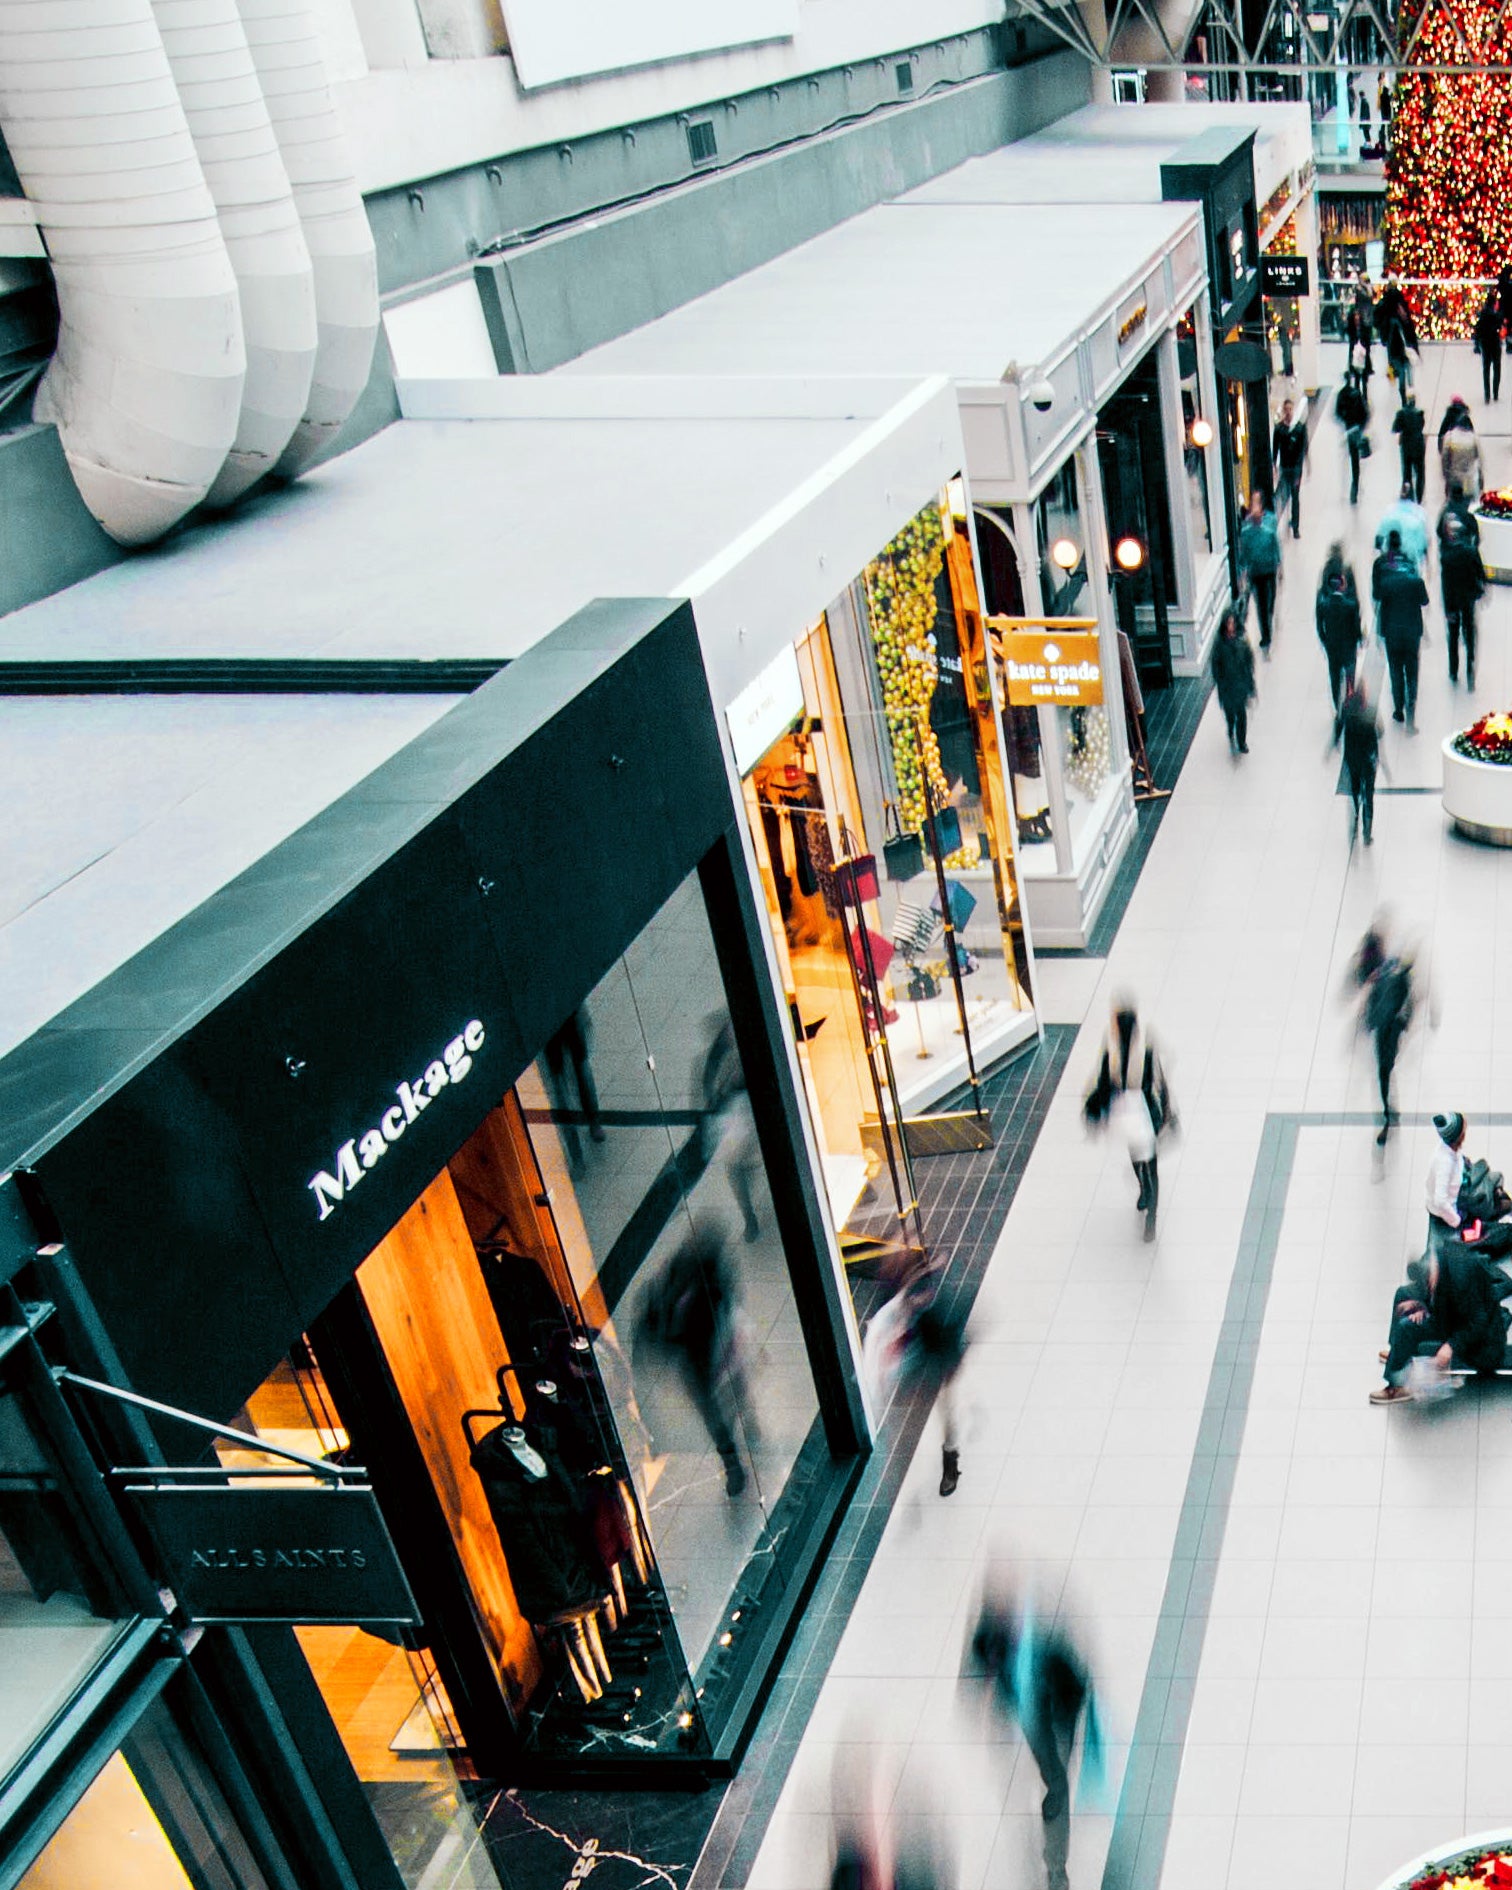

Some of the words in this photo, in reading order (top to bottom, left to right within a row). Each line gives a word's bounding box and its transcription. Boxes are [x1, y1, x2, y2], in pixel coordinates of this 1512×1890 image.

[1008, 659, 1046, 680] kate
[1050, 660, 1100, 685] spade
[308, 1019, 485, 1221] Mackage
[192, 1550, 367, 1568] ALLSAINTS
